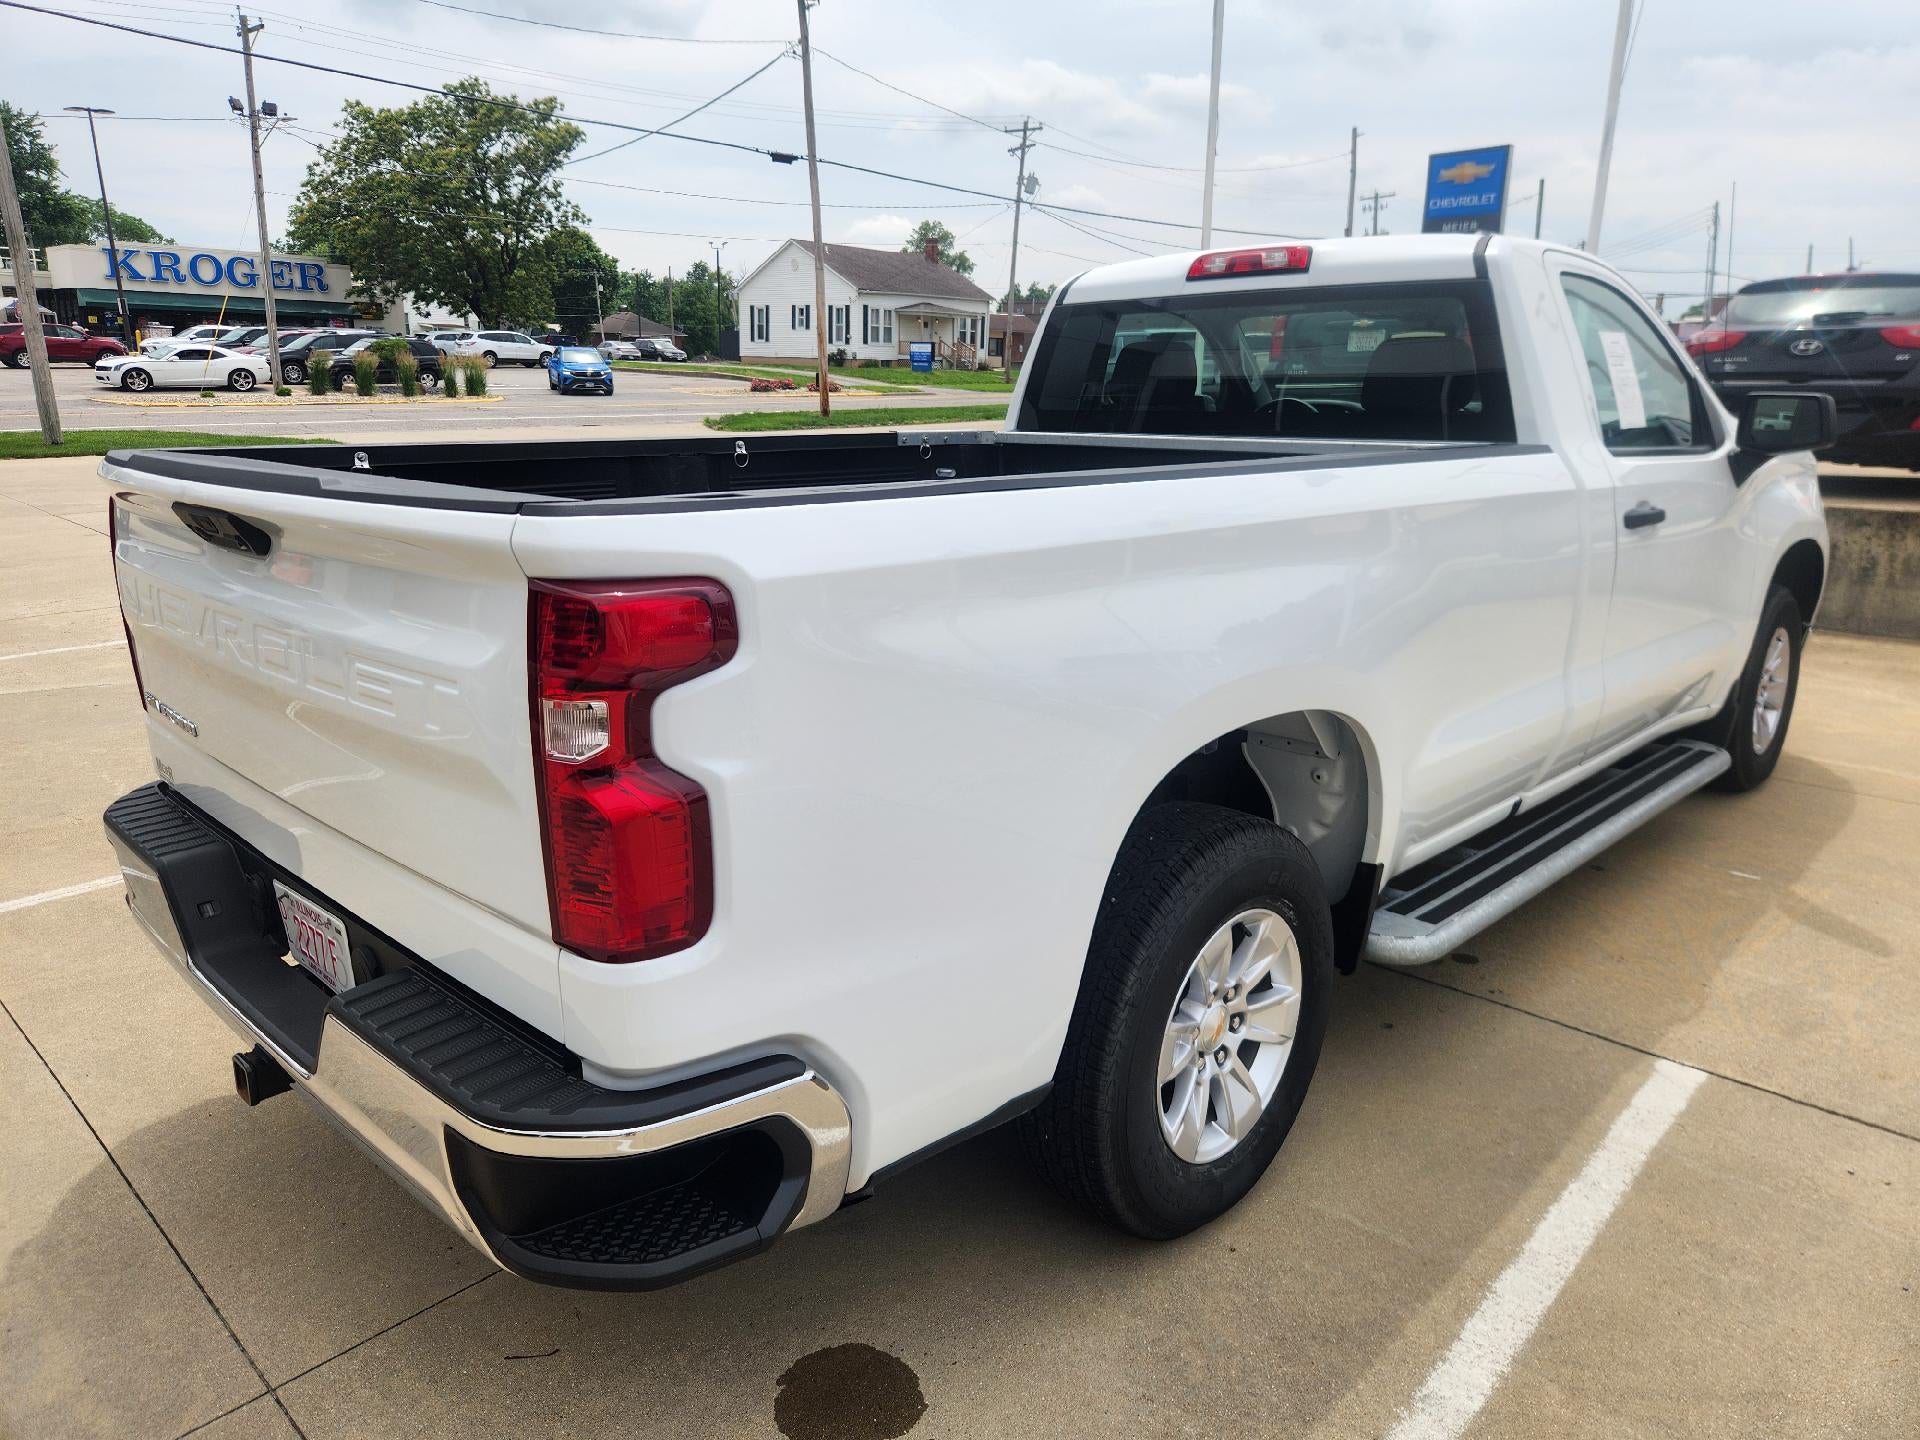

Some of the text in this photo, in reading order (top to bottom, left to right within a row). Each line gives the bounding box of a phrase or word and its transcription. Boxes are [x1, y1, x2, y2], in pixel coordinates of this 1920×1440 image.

[1429, 194, 1496, 209] CHEVROLET
[1442, 221, 1478, 232] MEIER
[102, 247, 329, 293] KROGER
[293, 915, 328, 972] 2277
[328, 937, 337, 979] F
